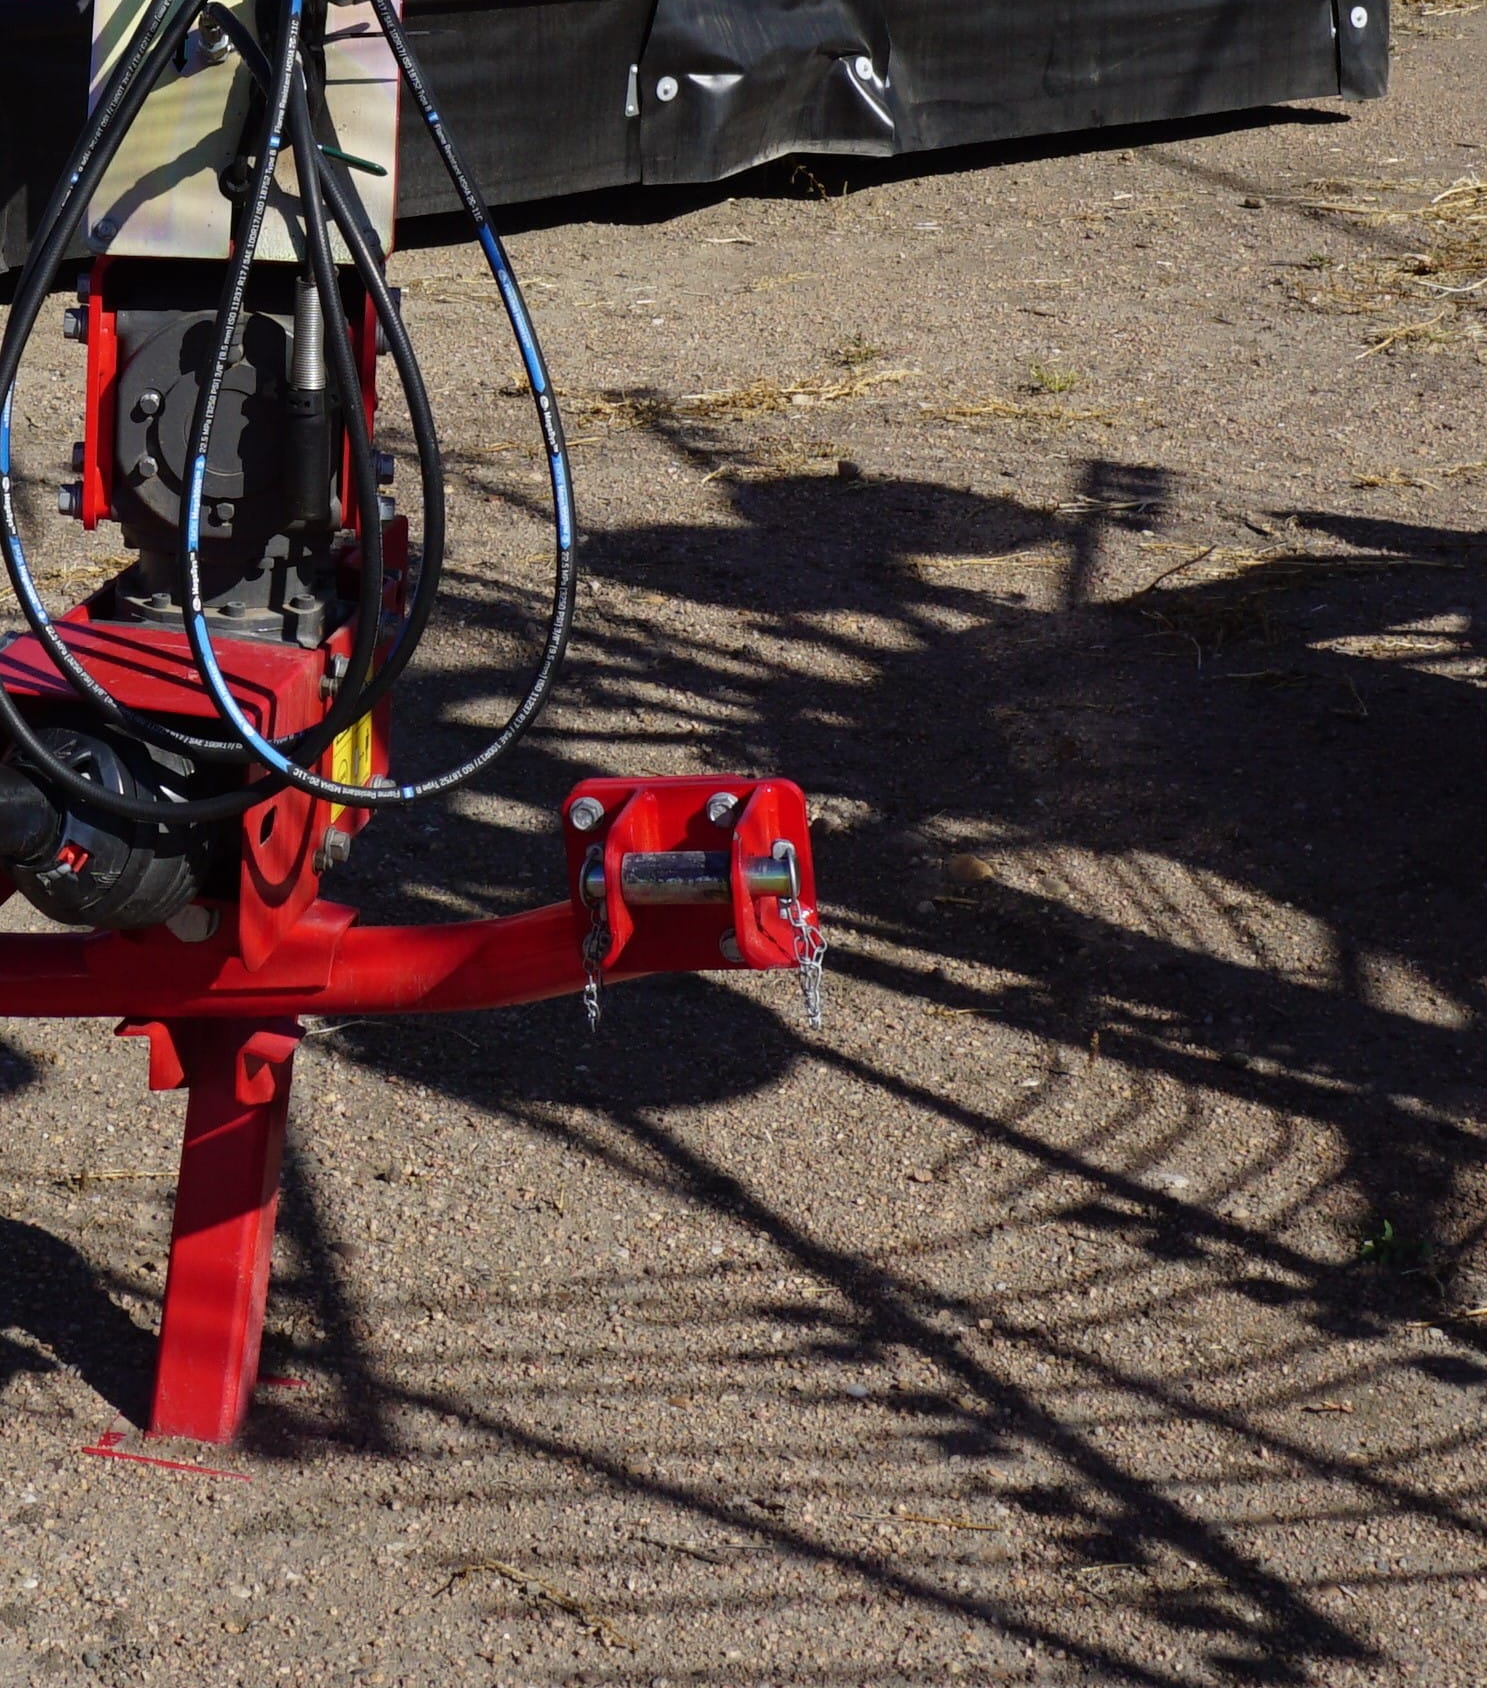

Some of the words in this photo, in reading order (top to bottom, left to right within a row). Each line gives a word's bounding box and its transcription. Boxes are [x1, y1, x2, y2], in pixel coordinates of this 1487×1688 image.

[277, 71, 292, 109] Resistant
[272, 109, 285, 134] Flame
[264, 155, 276, 175] Type
[441, 142, 463, 177] Resistant
[258, 173, 272, 200] 18752
[254, 199, 265, 215] ISO
[241, 248, 253, 265] SAE
[236, 269, 248, 287] R17
[230, 285, 244, 311] 11237
[533, 677, 546, 693] ISO
[520, 689, 540, 715] 11237
[511, 711, 527, 729] R17
[498, 729, 513, 745] SAE
[437, 768, 463, 786] 18752
[460, 761, 476, 775] ISO
[340, 786, 376, 799] Resistant
[376, 789, 401, 799] Flame
[421, 779, 440, 792] Type
